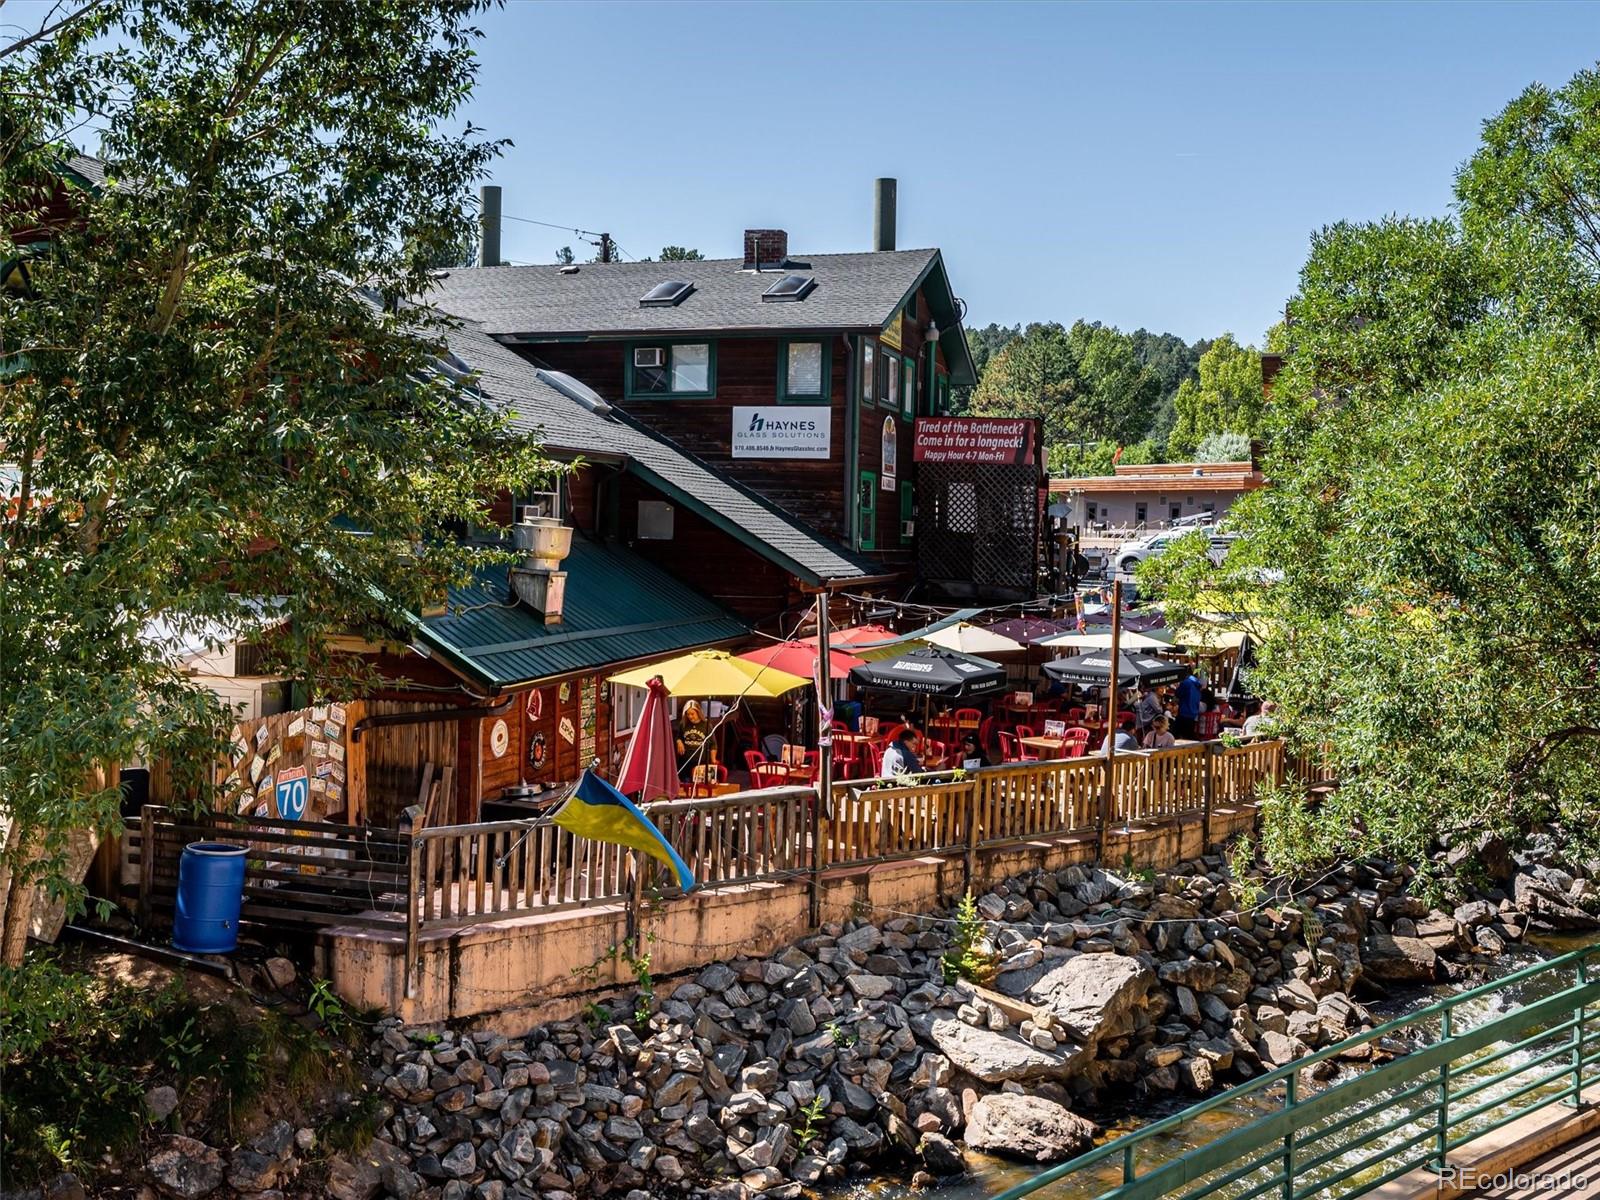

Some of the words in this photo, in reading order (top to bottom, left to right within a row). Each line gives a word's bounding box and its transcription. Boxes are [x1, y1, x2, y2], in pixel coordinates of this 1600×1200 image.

[766, 421, 815, 431] HAYNES
[918, 421, 941, 433] Tired
[942, 421, 952, 433] of
[953, 422, 968, 433] the
[970, 422, 1024, 435] Bottleneck?
[917, 434, 942, 446] Come
[944, 434, 954, 446] in
[955, 434, 969, 447] for
[970, 439, 976, 447] a
[977, 435, 1024, 450] longneck!
[924, 450, 947, 461] Happy
[947, 451, 965, 460] Hour
[965, 451, 977, 460] 4-7
[978, 451, 1005, 461] Mon-Fri
[279, 781, 305, 816] 70
